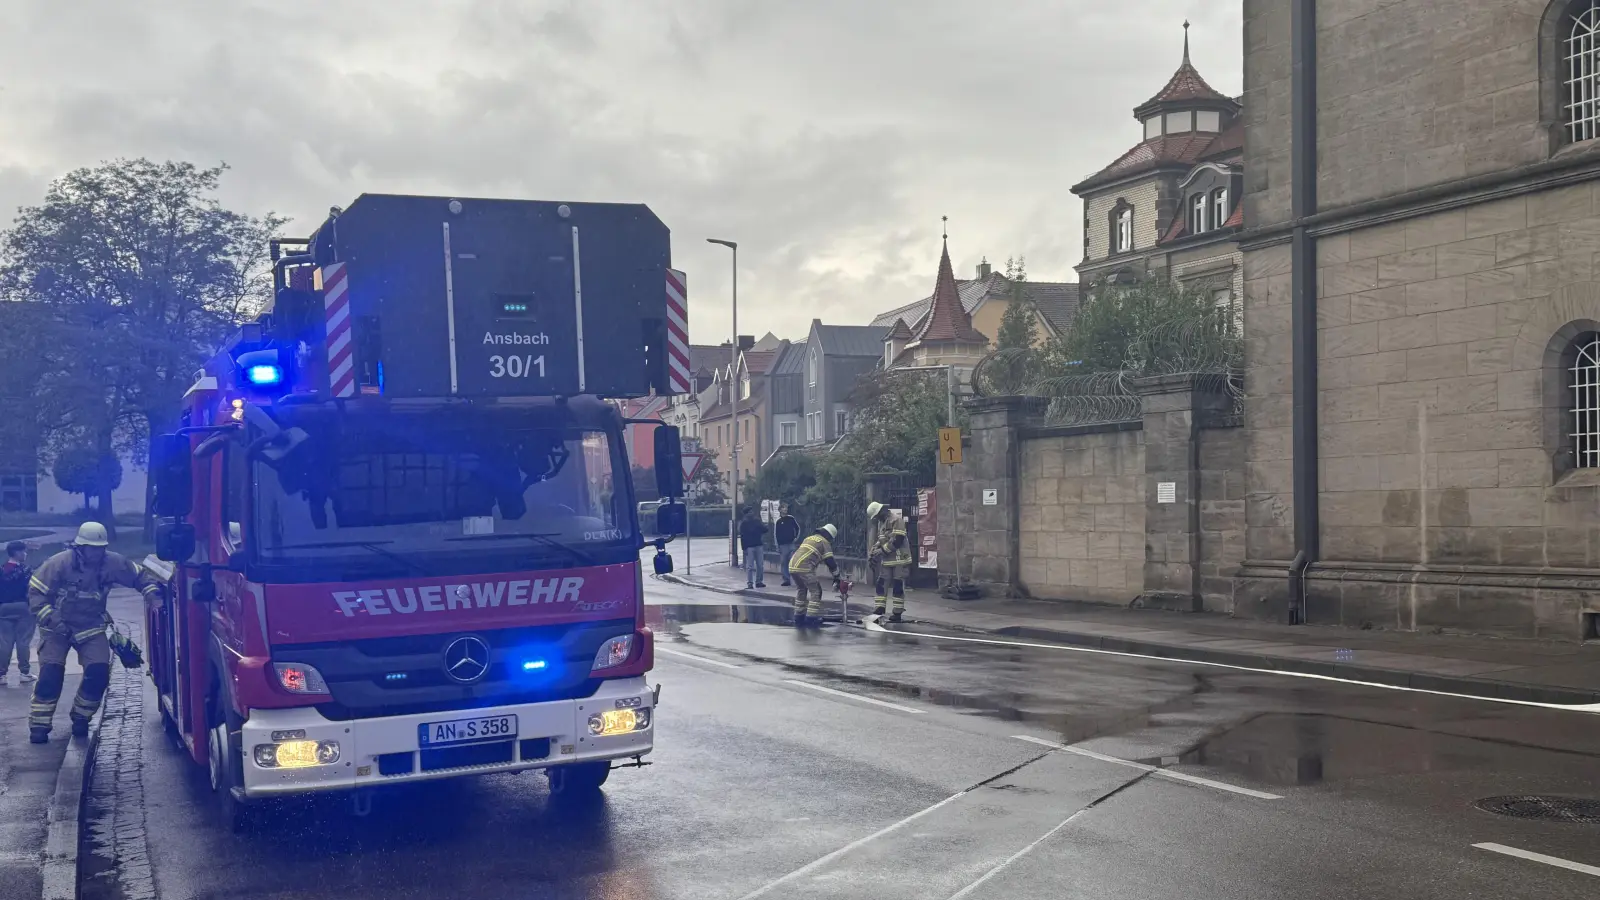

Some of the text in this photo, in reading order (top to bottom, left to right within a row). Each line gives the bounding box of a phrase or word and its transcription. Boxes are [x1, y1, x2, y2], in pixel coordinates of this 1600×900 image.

[483, 331, 549, 345] Ansbach
[489, 355, 545, 378] 30/1
[943, 432, 950, 442] U
[332, 576, 584, 617] FEUERWEHR
[436, 718, 509, 740] AN S 358
